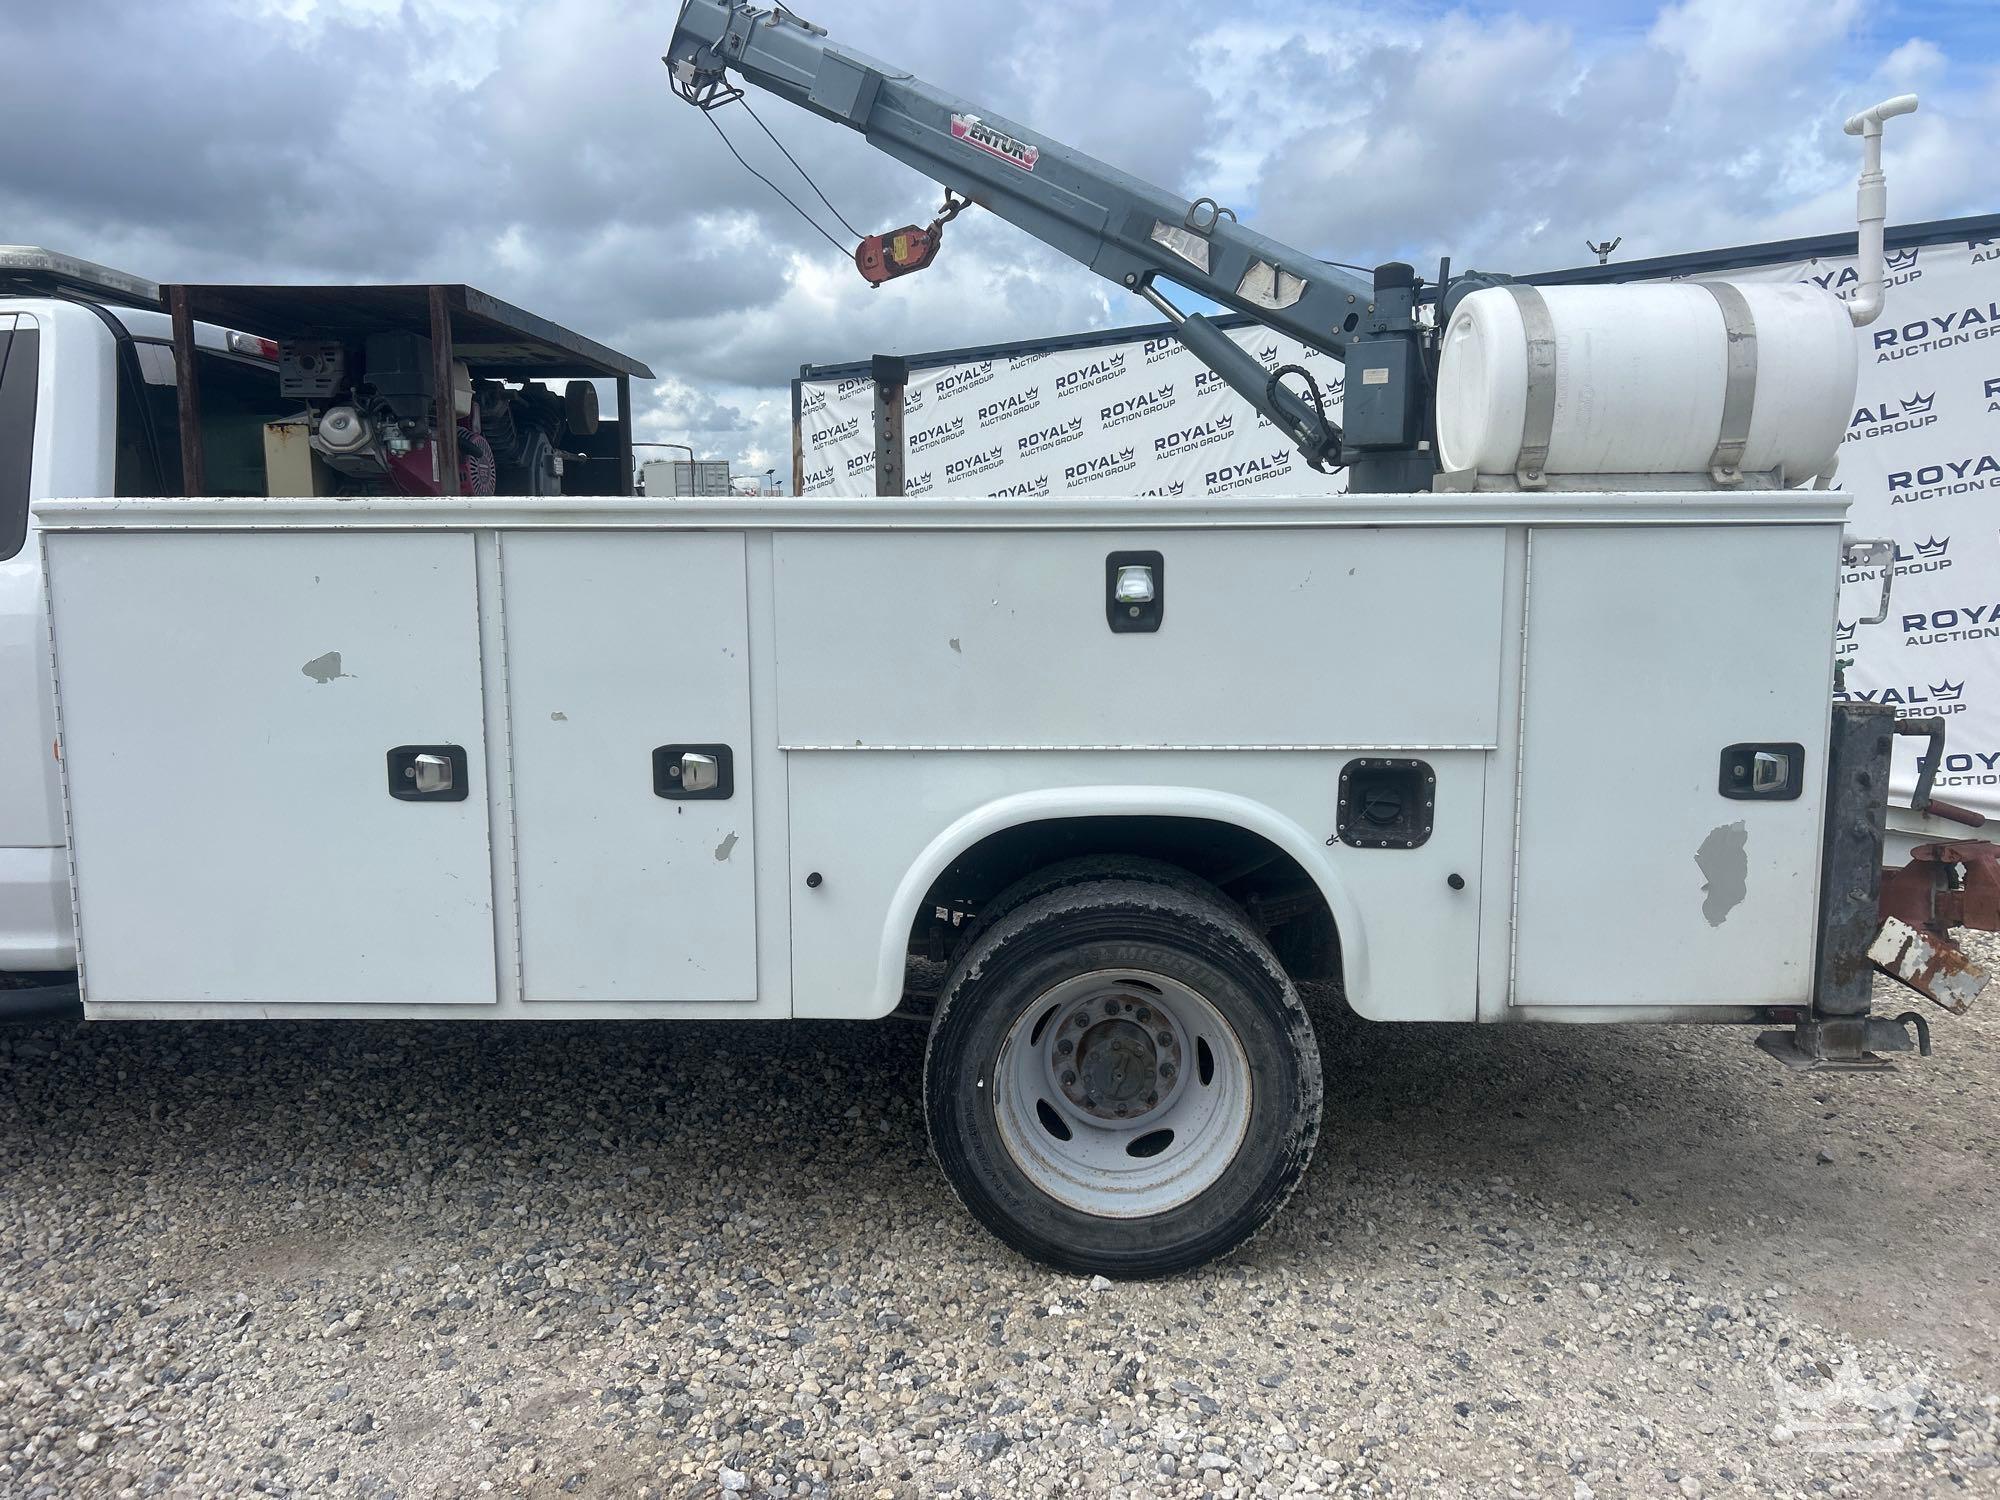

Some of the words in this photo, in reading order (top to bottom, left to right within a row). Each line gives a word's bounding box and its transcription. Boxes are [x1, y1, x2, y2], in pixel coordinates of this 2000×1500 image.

[1877, 332, 1969, 364] AUCTION
[936, 367, 981, 393] ROYAL
[937, 385, 968, 401] AUCTION
[969, 373, 994, 388] GROUP
[1055, 360, 1110, 390] ROYAL
[1057, 380, 1095, 399] AUCTION
[1095, 367, 1126, 385] GROUP
[1197, 382, 1229, 397] AUCTI
[978, 393, 1026, 420] ROYAL
[980, 409, 1013, 428] AUCTION
[1013, 400, 1040, 416] GROUP
[1100, 391, 1158, 420] ROYAL
[1102, 411, 1142, 430] AUCTION
[1143, 399, 1176, 416] GROUP
[812, 422, 848, 444] ROYAL
[909, 422, 952, 447] ROYAL
[1018, 424, 1069, 450] ROYAL
[1154, 422, 1216, 452] ROYAL
[1866, 415, 1938, 438] GROUP
[813, 438, 839, 451] AUCTION
[839, 429, 860, 442] GROUP
[911, 439, 940, 455] AUCTION
[941, 429, 965, 444] GROUP
[1020, 441, 1055, 459] AUCTION
[1055, 431, 1084, 446] GROUP
[1156, 441, 1199, 461] AUCTION
[1199, 430, 1235, 447] GROUP
[847, 451, 876, 470] ROYA
[945, 452, 991, 476] ROYAL
[947, 468, 978, 484] AUCTION
[978, 459, 1004, 474] GROUP
[1065, 453, 1120, 480] ROYAL
[1205, 457, 1272, 486] ROYAL
[1888, 455, 2000, 491] ROYA
[803, 470, 827, 486] YAL
[1066, 471, 1104, 489] AUCTION
[1104, 461, 1136, 477] GROUP
[1207, 477, 1253, 496] AUCTION
[1254, 465, 1292, 483] GROUP
[910, 484, 933, 497] GROUP
[1890, 479, 1985, 505] AUCTION
[1905, 627, 2000, 647] AUCTION
[1895, 704, 1967, 718] GROUP
[1933, 774, 2000, 787] UCTIO
